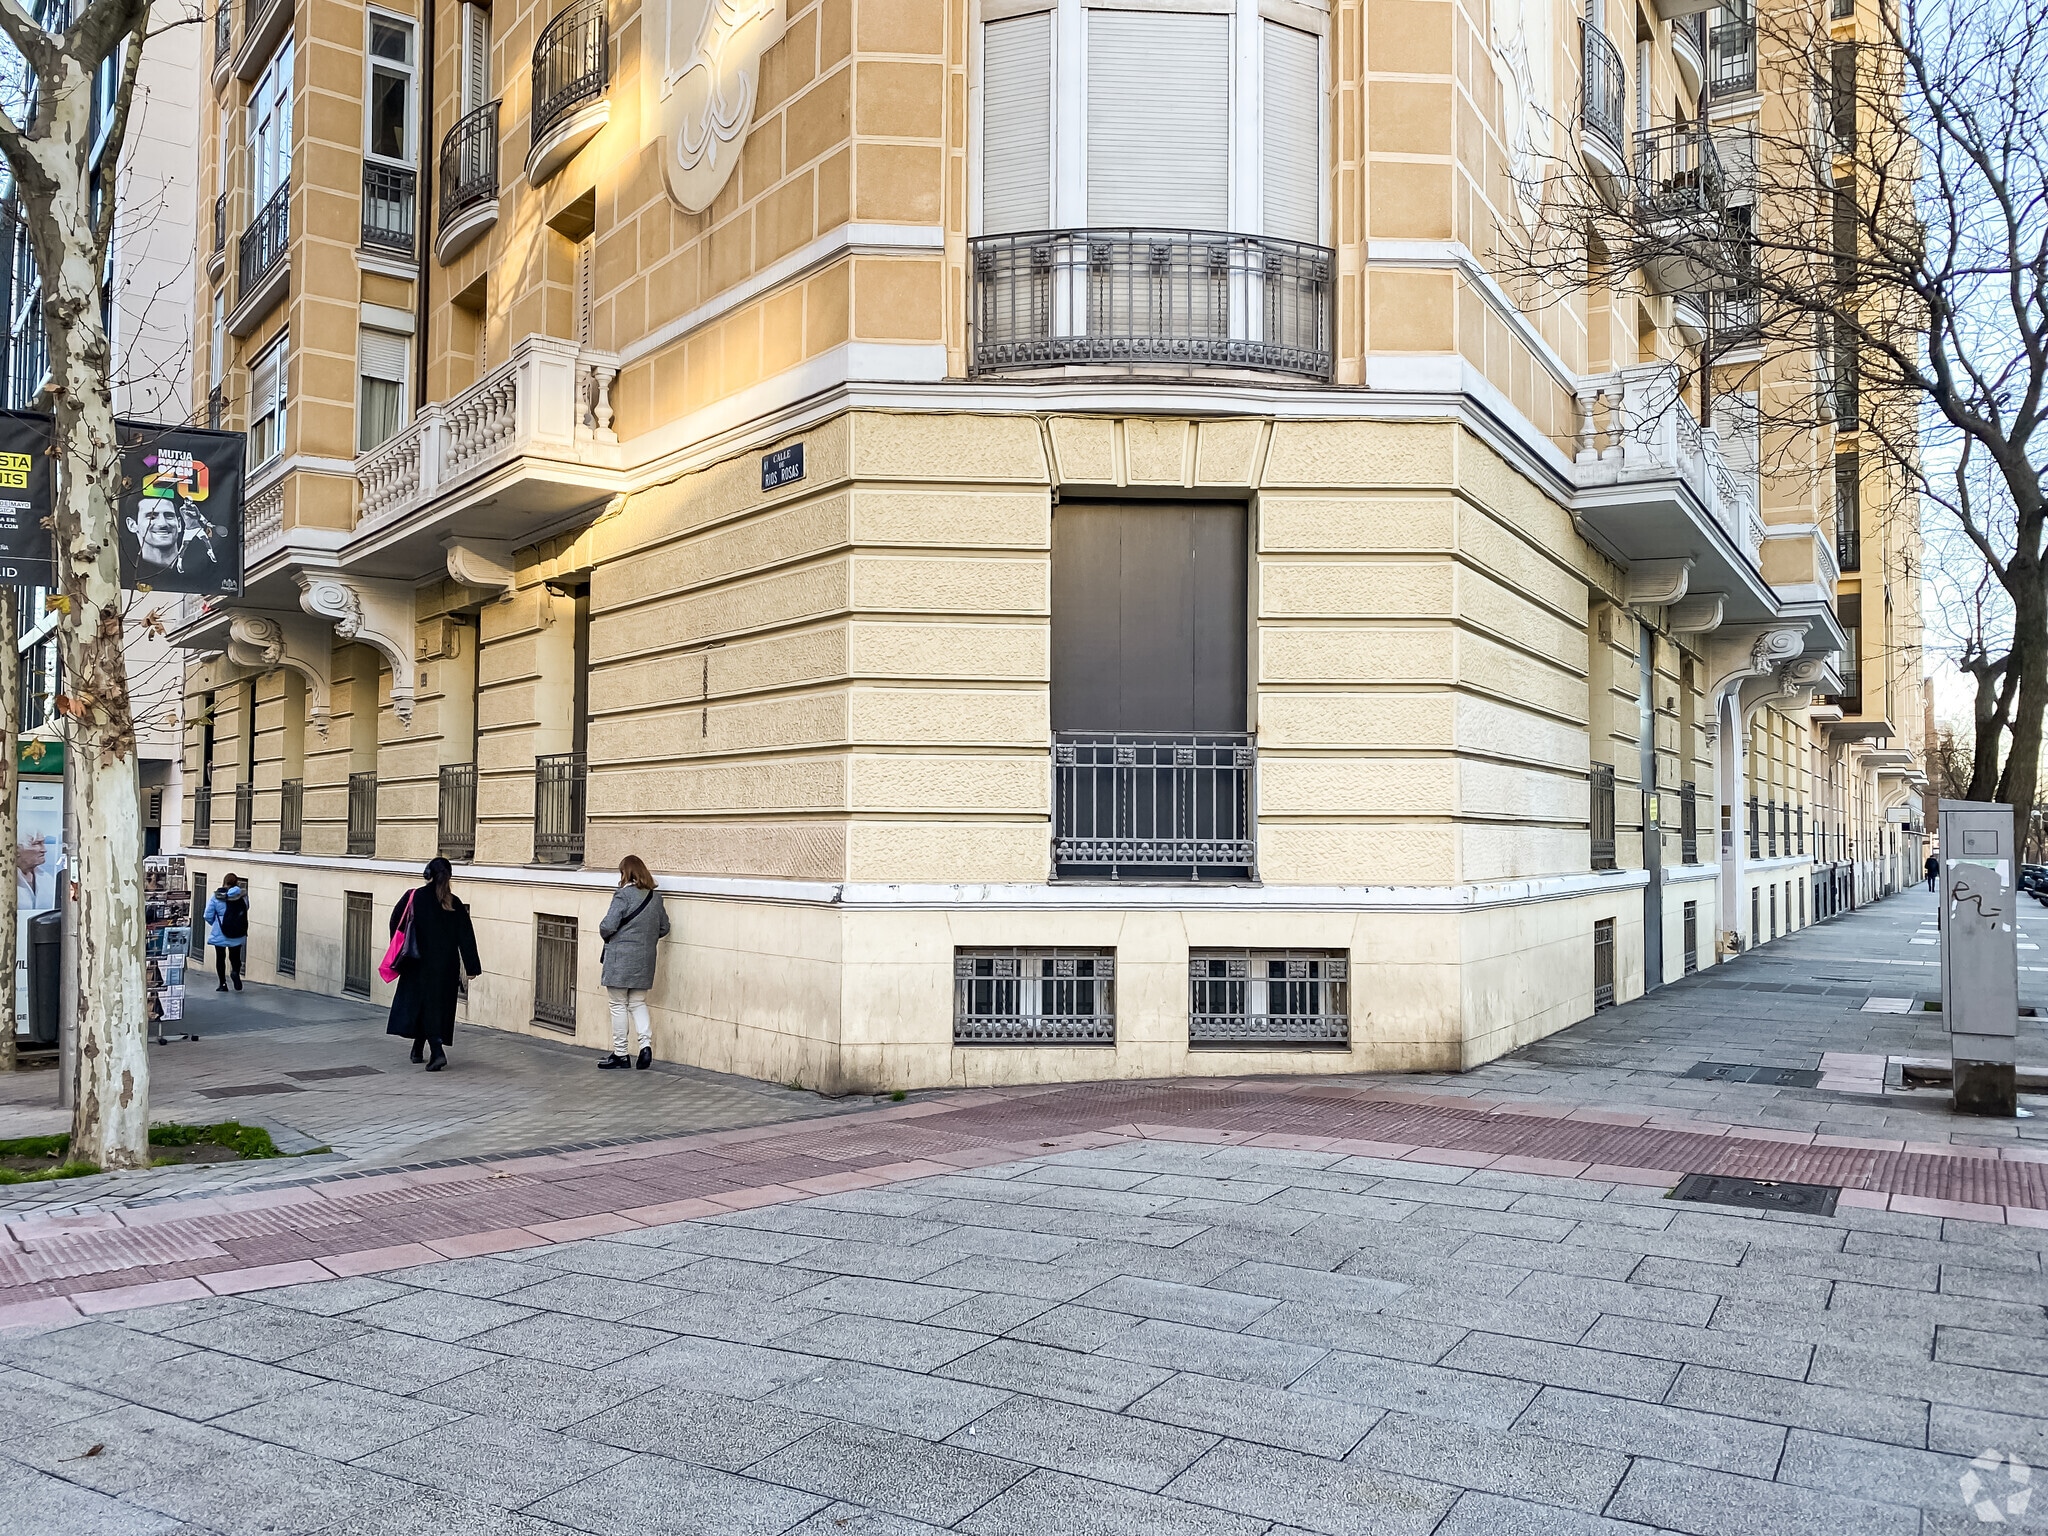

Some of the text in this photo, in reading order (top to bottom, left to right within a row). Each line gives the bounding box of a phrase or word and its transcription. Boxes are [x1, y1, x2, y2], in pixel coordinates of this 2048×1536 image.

[0, 456, 29, 468] STA
[773, 450, 791, 463] CALLE
[781, 463, 799, 481] ROSAS
[0, 473, 24, 485] IS
[0, 567, 18, 577] ID
